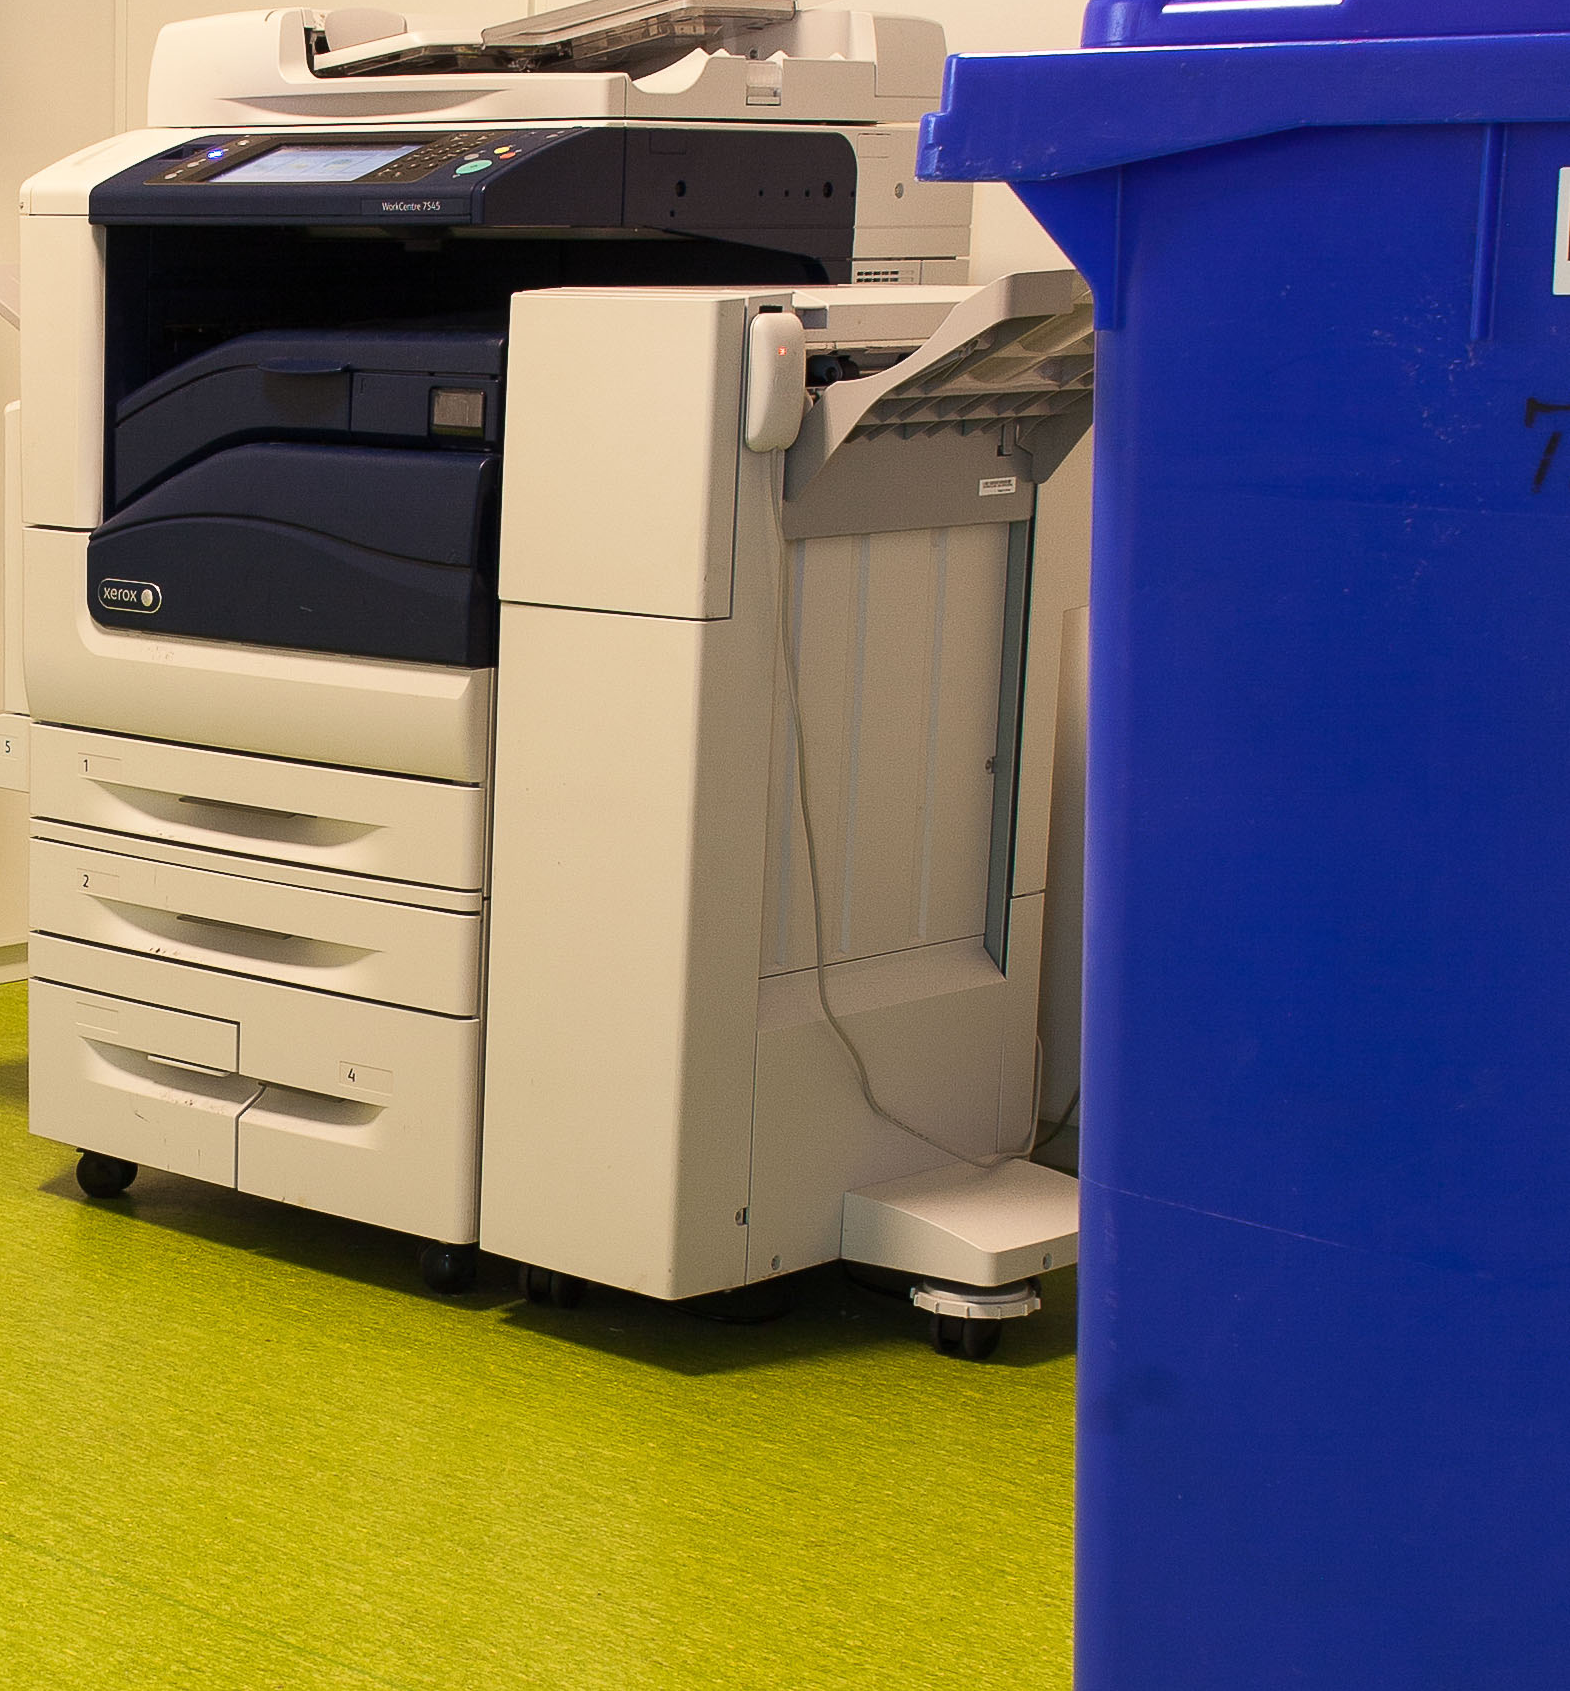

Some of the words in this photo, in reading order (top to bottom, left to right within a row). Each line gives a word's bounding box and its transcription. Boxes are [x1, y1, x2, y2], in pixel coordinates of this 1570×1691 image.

[381, 201, 421, 211] WorkCentre
[422, 200, 441, 211] 7545
[103, 587, 137, 603] xerox
[5, 740, 11, 754] 5
[83, 759, 89, 773] 1
[82, 874, 89, 888] 2
[347, 1067, 355, 1083] 4
